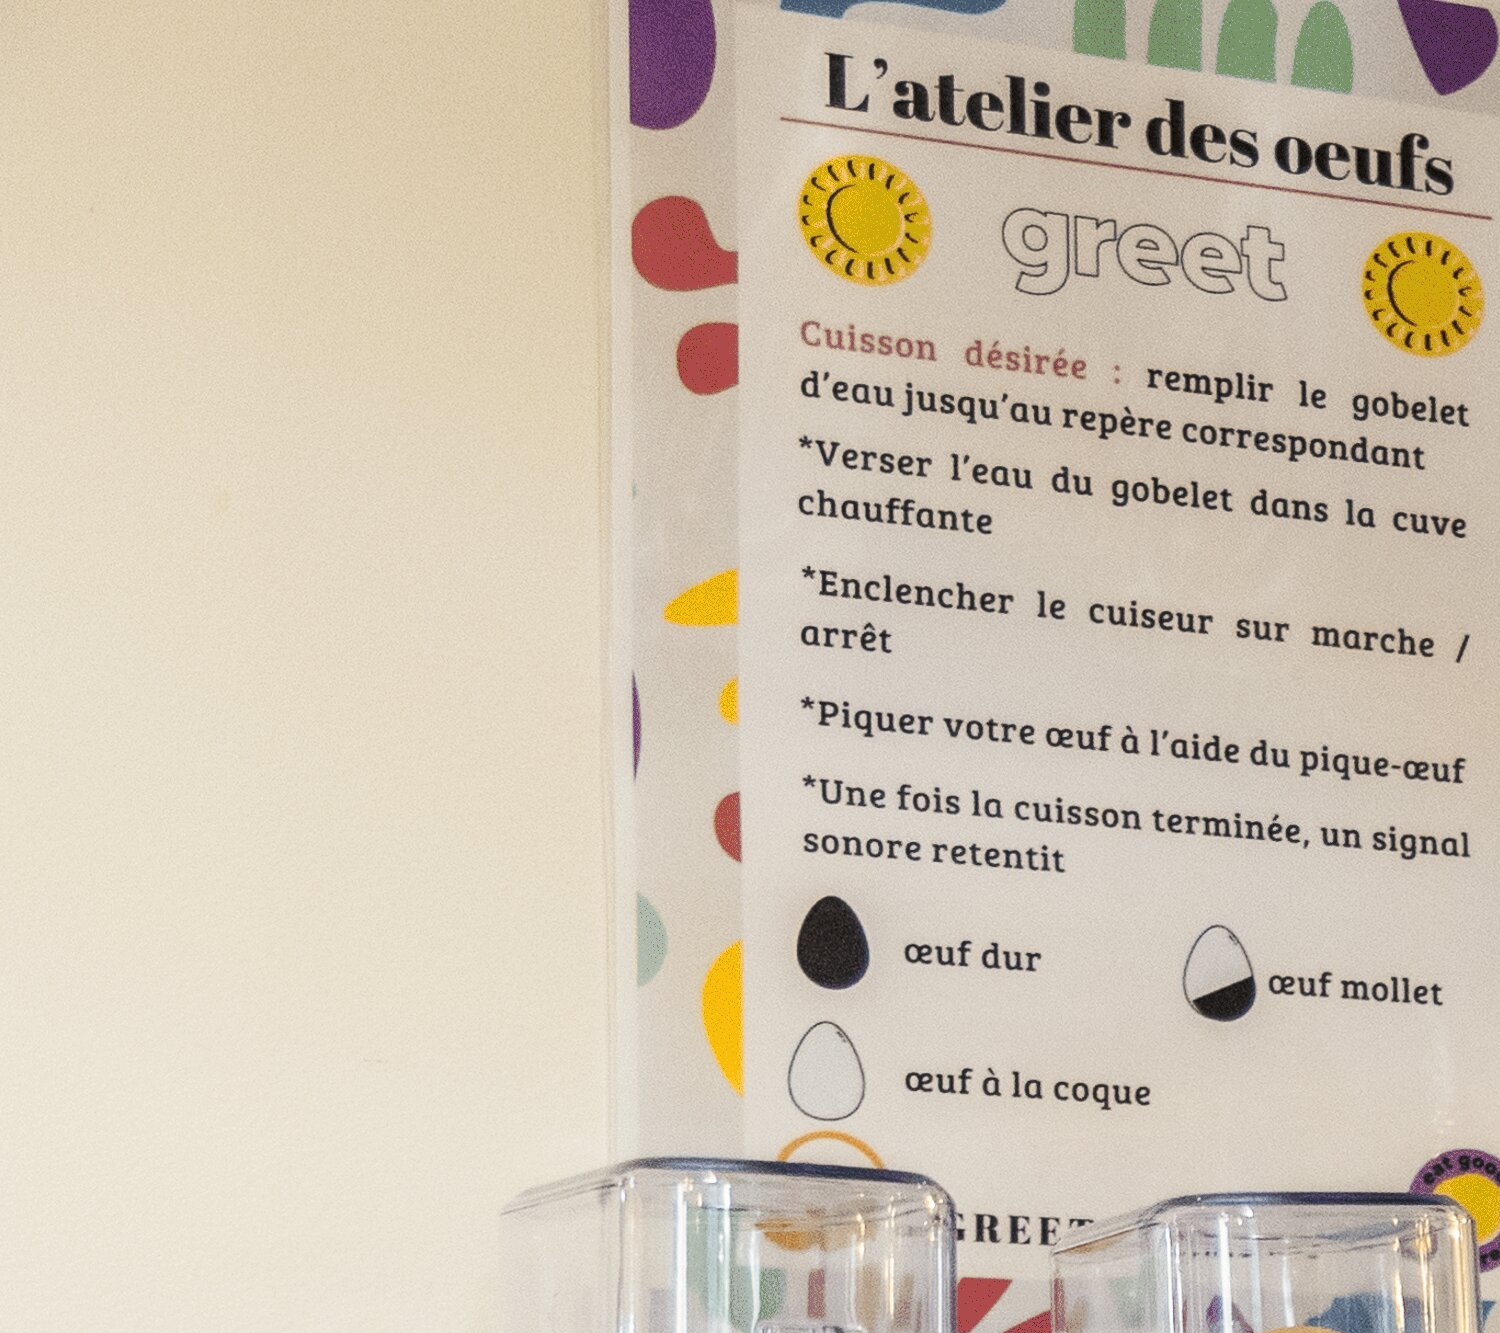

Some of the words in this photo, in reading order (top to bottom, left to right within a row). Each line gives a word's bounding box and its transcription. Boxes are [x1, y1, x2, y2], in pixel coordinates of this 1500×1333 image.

[824, 52, 1131, 149] L'atelier
[1144, 97, 1260, 169] des
[1273, 132, 1455, 196] oeufs
[1001, 206, 1289, 303] greet
[800, 320, 937, 362] Cuisson
[964, 339, 1087, 380] désirée
[1113, 364, 1121, 385] :
[1146, 368, 1274, 405] remplir
[1298, 379, 1327, 410] le
[1351, 390, 1470, 428] gobelet
[799, 369, 895, 408] d'eau
[901, 381, 1053, 427] jusqu'au
[1061, 405, 1172, 441] repère
[1181, 422, 1426, 471] correspondant
[797, 488, 993, 535] chauffante
[950, 452, 1033, 490] l'eau
[1051, 465, 1094, 497] du
[1111, 476, 1234, 513] gobelet
[1249, 488, 1329, 523] dans
[1345, 498, 1376, 529] la
[1392, 511, 1467, 539] cuve
[800, 621, 893, 654] arrêt
[1036, 589, 1066, 621] le
[1088, 599, 1214, 635] cuiseur
[1235, 617, 1290, 643] sur
[1311, 625, 1435, 658] marche
[1455, 633, 1471, 664] /
[942, 717, 1036, 746] votre
[1044, 724, 1113, 752] œuf
[1120, 724, 1141, 755] à
[1149, 728, 1240, 764] l'aide
[1249, 738, 1291, 769] du
[1299, 744, 1467, 785] pique-œuf
[802, 832, 922, 862] sonore
[931, 843, 1066, 874] retentit
[896, 783, 961, 816] fois
[971, 789, 1004, 819] la
[1013, 796, 1143, 831] cuisson
[1151, 809, 1310, 849] terminée,
[1319, 826, 1363, 850] un
[1371, 825, 1471, 861] signal
[903, 939, 973, 968] œuf
[980, 941, 1043, 973] dur
[1267, 970, 1333, 998] œuf
[1340, 975, 1444, 1007] mollet
[904, 1067, 974, 1096] œuf
[981, 1066, 1003, 1098] à
[1011, 1070, 1044, 1100] la
[1052, 1080, 1152, 1112] coque
[1422, 1157, 1453, 1186] eat
